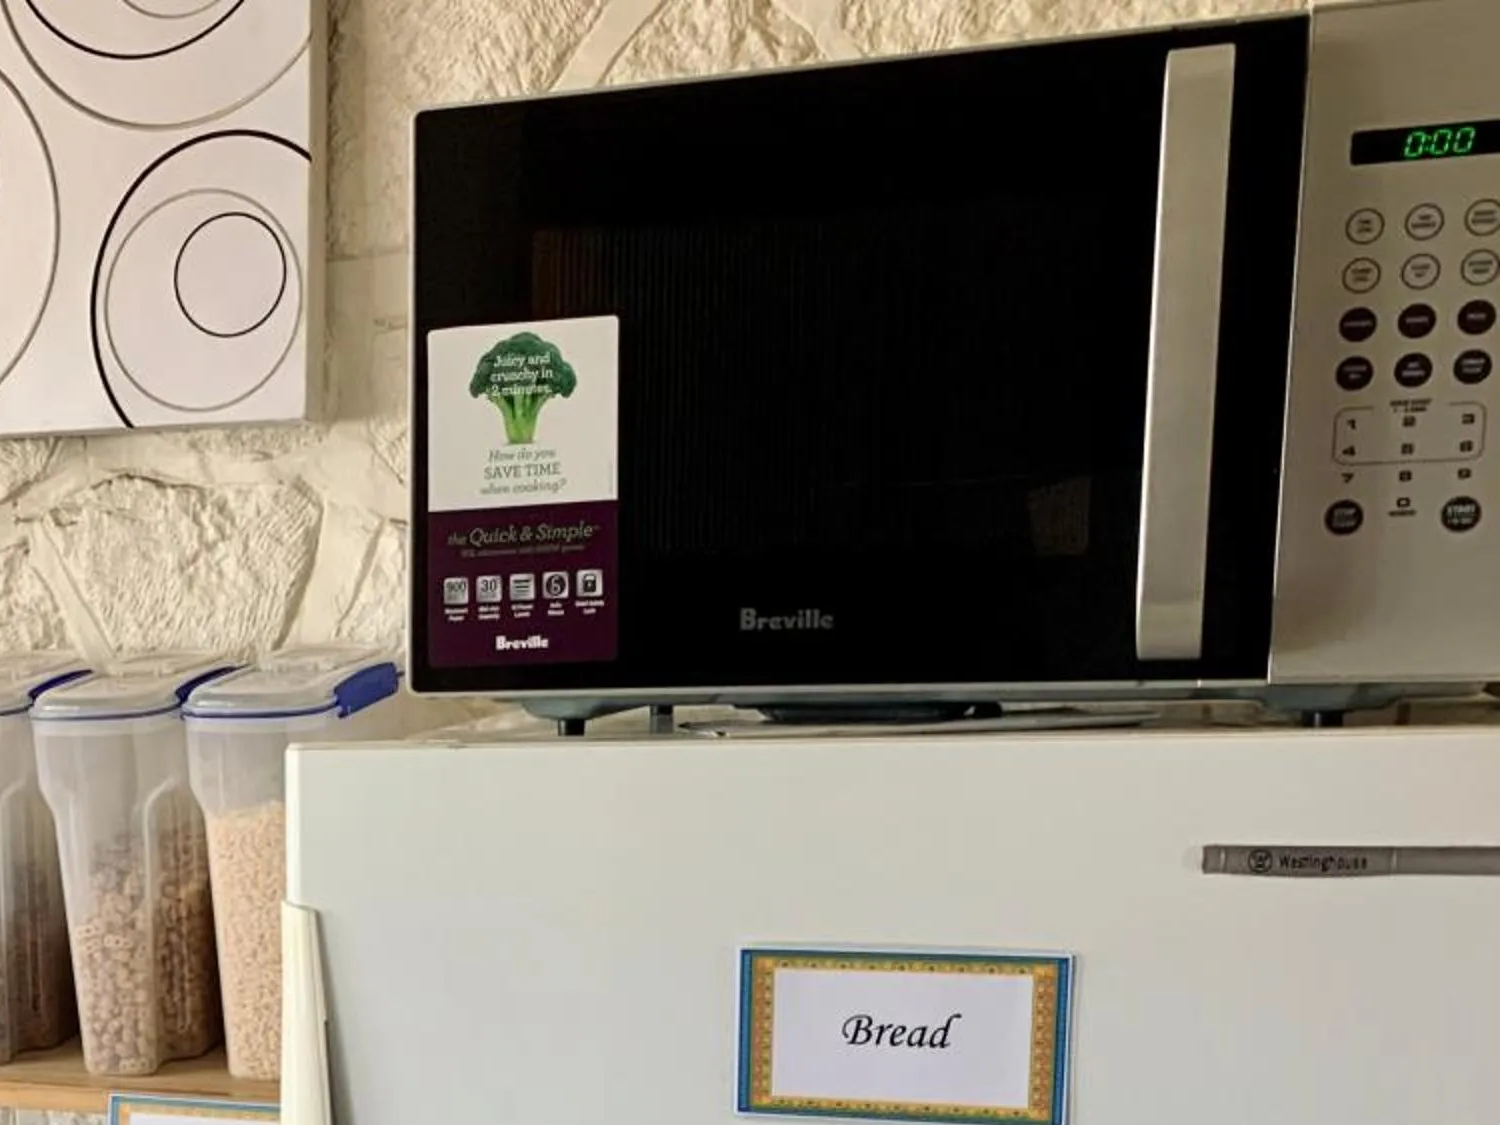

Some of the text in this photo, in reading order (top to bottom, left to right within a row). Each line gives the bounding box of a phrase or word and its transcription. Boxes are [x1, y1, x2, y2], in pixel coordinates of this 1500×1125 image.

[1403, 126, 1476, 158] 0:00
[483, 462, 561, 480] SAVE TIME
[469, 524, 519, 547] Quick
[520, 525, 533, 542] &
[739, 607, 835, 632] Breville
[496, 634, 549, 651] Breville
[841, 1013, 962, 1049] Bread
